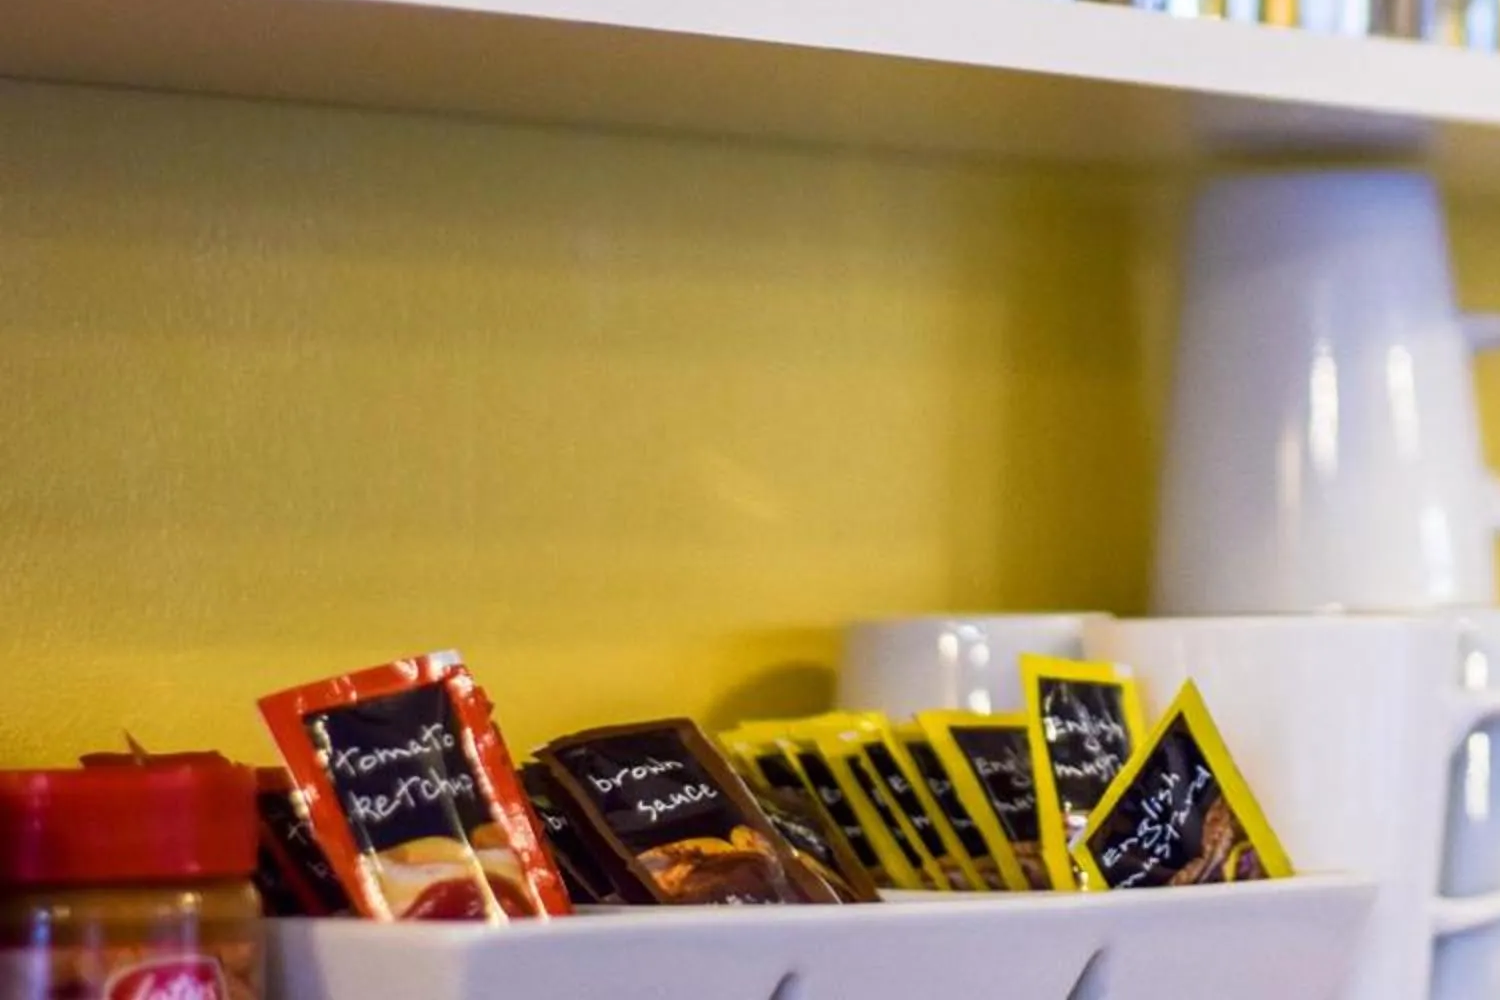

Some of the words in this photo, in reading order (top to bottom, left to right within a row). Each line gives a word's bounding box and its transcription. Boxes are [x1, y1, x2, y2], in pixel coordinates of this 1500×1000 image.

[335, 722, 455, 776] tomato
[588, 756, 684, 793] brown
[350, 767, 475, 821] ketchup
[637, 781, 719, 822] sauce
[1102, 771, 1180, 868] English
